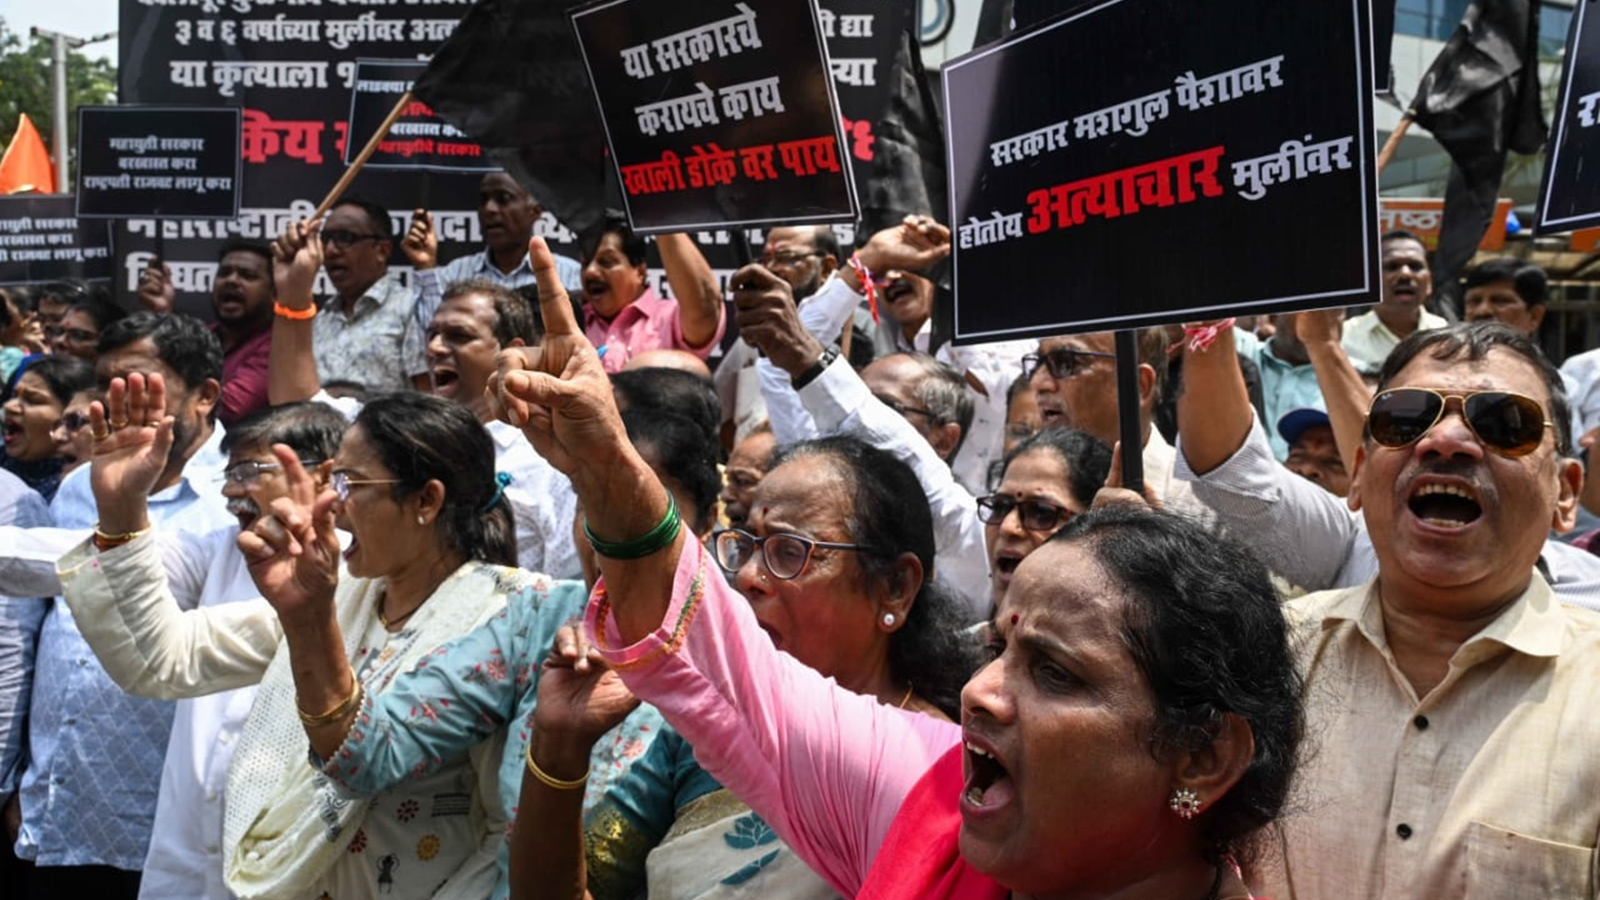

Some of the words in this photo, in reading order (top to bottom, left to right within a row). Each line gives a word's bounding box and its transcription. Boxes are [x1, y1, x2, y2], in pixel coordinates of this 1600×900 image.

[242, 13, 321, 42] वर्षाच्या
[324, 11, 406, 49] मुलींवर
[620, 43, 654, 79] या
[651, 2, 762, 72] सरकारचे
[170, 61, 206, 88] या
[213, 61, 329, 96] कृत्याला
[634, 82, 719, 136] करायचे
[718, 76, 785, 120] काय
[990, 120, 1069, 167] सरकार
[1073, 89, 1171, 137] मशगुल
[1174, 55, 1284, 111] पैशावर
[171, 157, 197, 170] करा
[621, 150, 685, 195] खाली
[684, 143, 736, 188] डोके
[739, 145, 778, 181] वर
[778, 135, 841, 176] पाय
[959, 210, 1023, 250] होतोय
[1026, 145, 1225, 234] अत्याचार
[1231, 134, 1354, 200] मुलींवर
